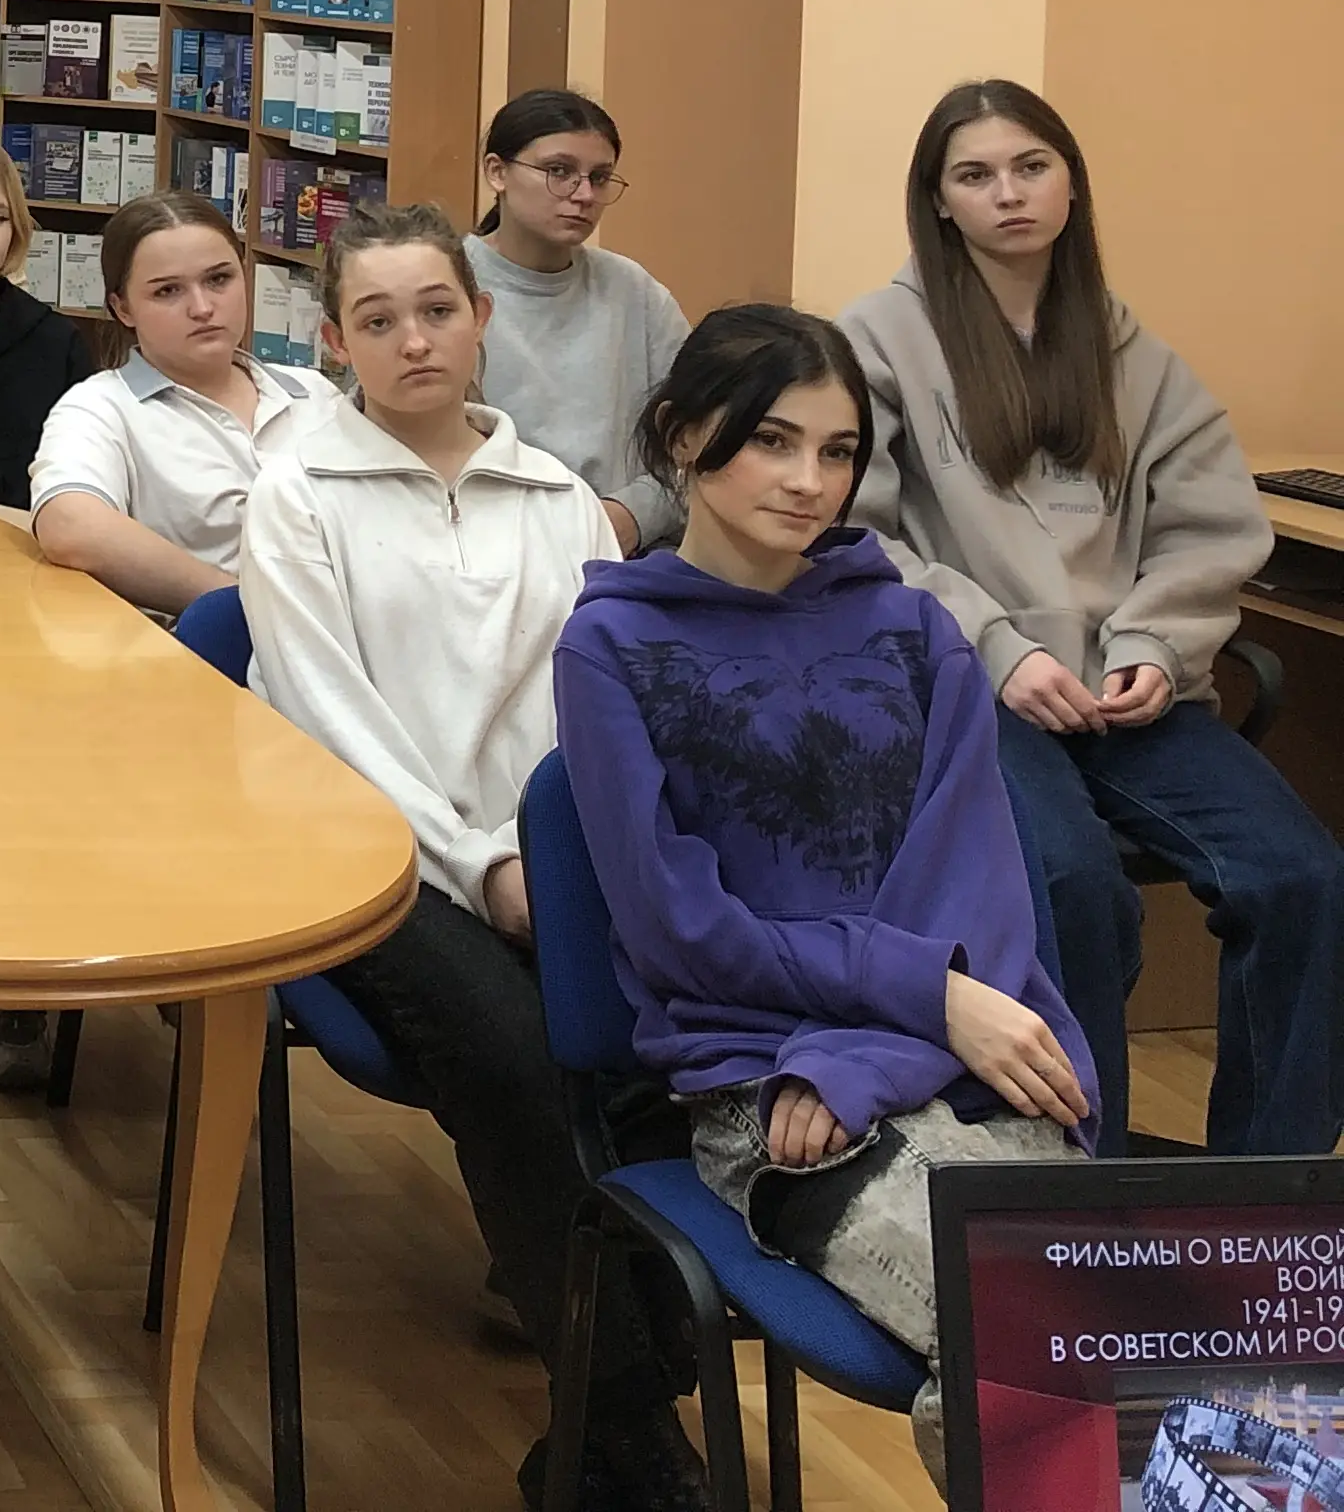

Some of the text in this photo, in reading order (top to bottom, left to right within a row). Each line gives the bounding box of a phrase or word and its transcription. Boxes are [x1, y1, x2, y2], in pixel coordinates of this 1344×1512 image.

[1045, 1240, 1181, 1268] ФИЛЬМЫ
[1188, 1239, 1211, 1265] О
[1051, 1326, 1344, 1362] В СОВЕТСКОМ И РО
